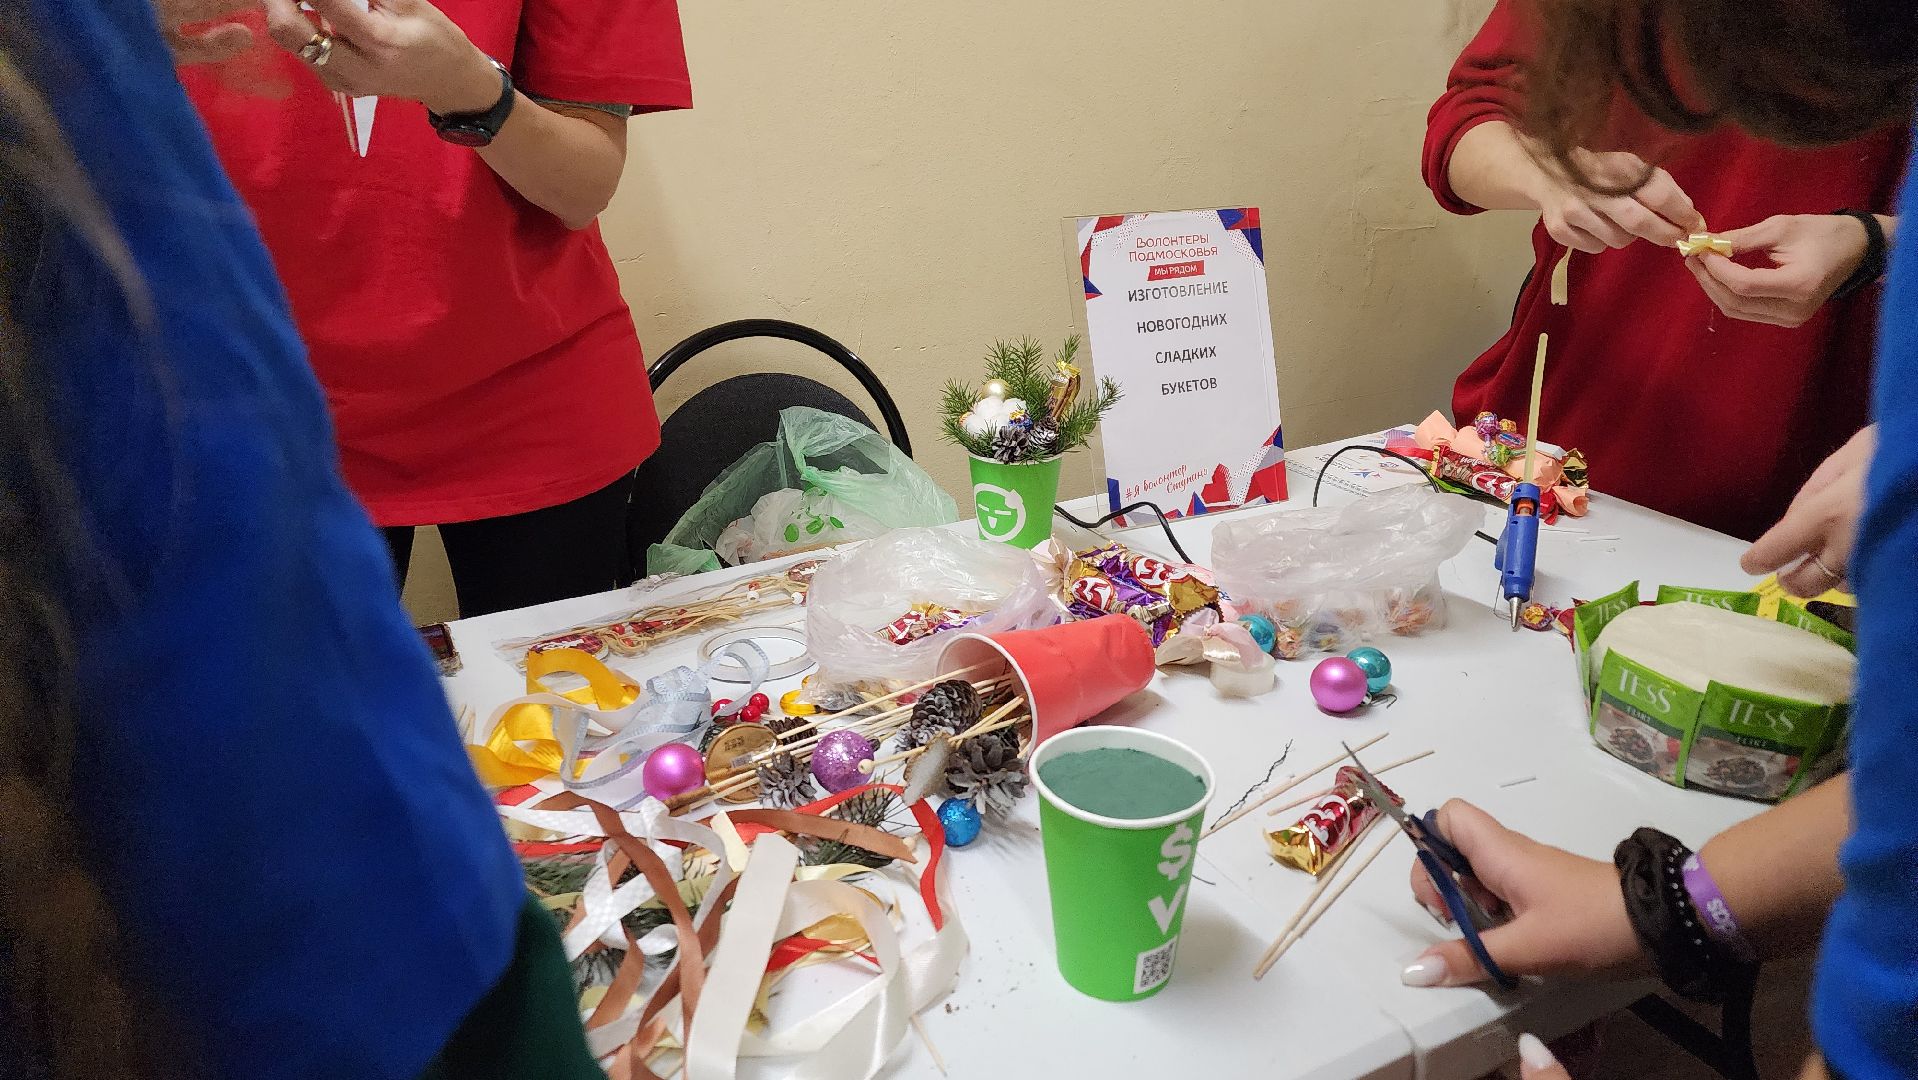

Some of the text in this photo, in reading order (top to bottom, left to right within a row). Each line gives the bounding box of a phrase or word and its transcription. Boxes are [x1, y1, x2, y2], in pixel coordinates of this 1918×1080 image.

[1136, 234, 1209, 248] ВОЛОНТЕРЫ
[1129, 246, 1218, 262] ПОДМОСКОВЬЯ
[1154, 264, 1198, 275] МЫ РЯДОМ
[1128, 281, 1228, 302] ИЗГОТОВЛЕНИЕ
[1137, 313, 1228, 334] НОВОГОДНИХ
[1155, 346, 1217, 364] СЛАДКИХ
[1161, 377, 1218, 396] БУКЕТОВ
[1618, 667, 1672, 713] TESS
[1729, 698, 1796, 736] TESS
